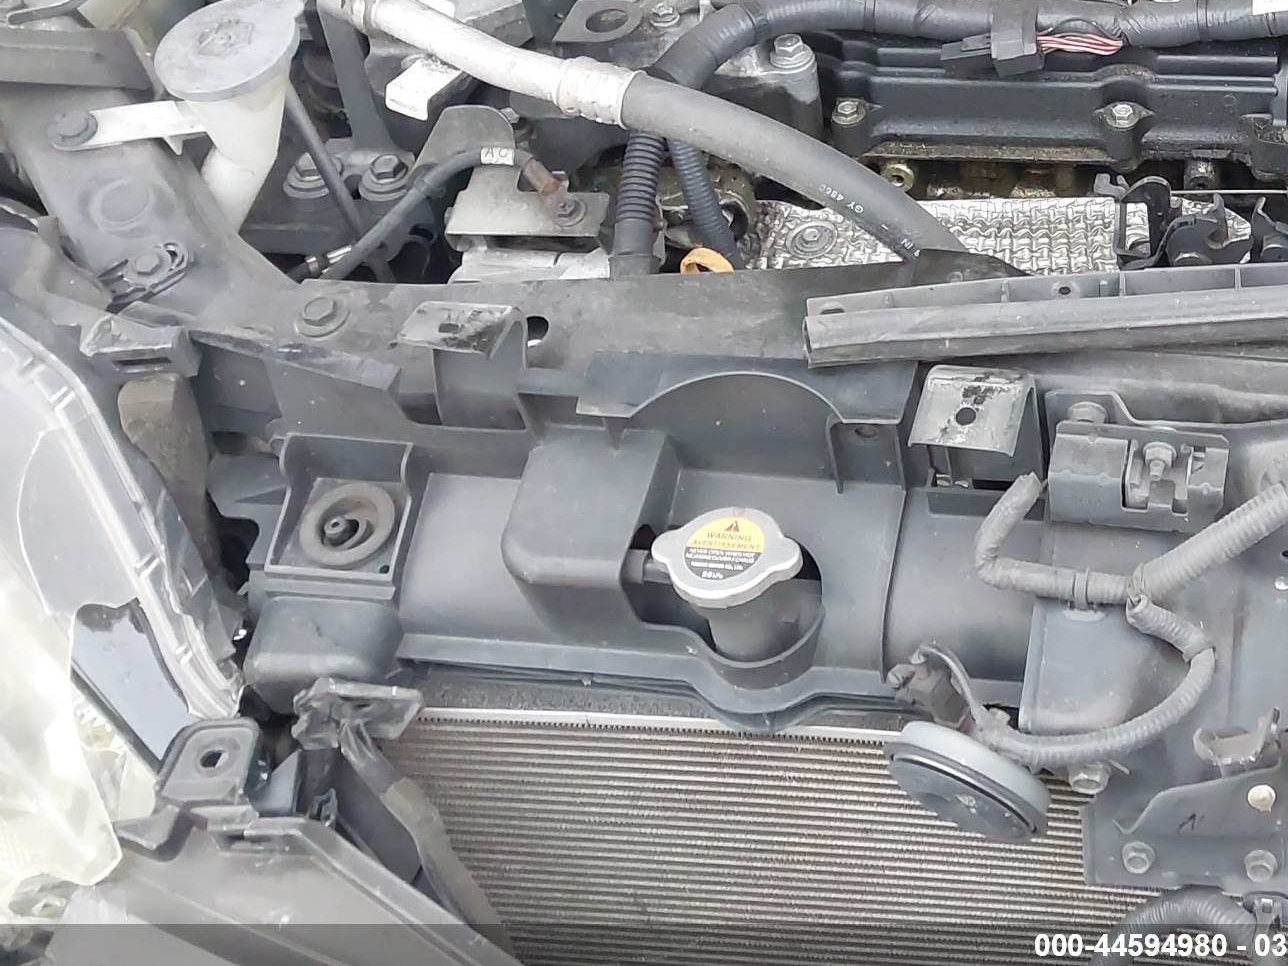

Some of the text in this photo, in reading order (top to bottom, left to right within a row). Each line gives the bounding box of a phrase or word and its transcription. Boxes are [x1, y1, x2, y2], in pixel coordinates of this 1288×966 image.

[846, 201, 864, 214] GY
[707, 531, 752, 542] WARNING
[692, 539, 760, 551] AVERTISSEMENT
